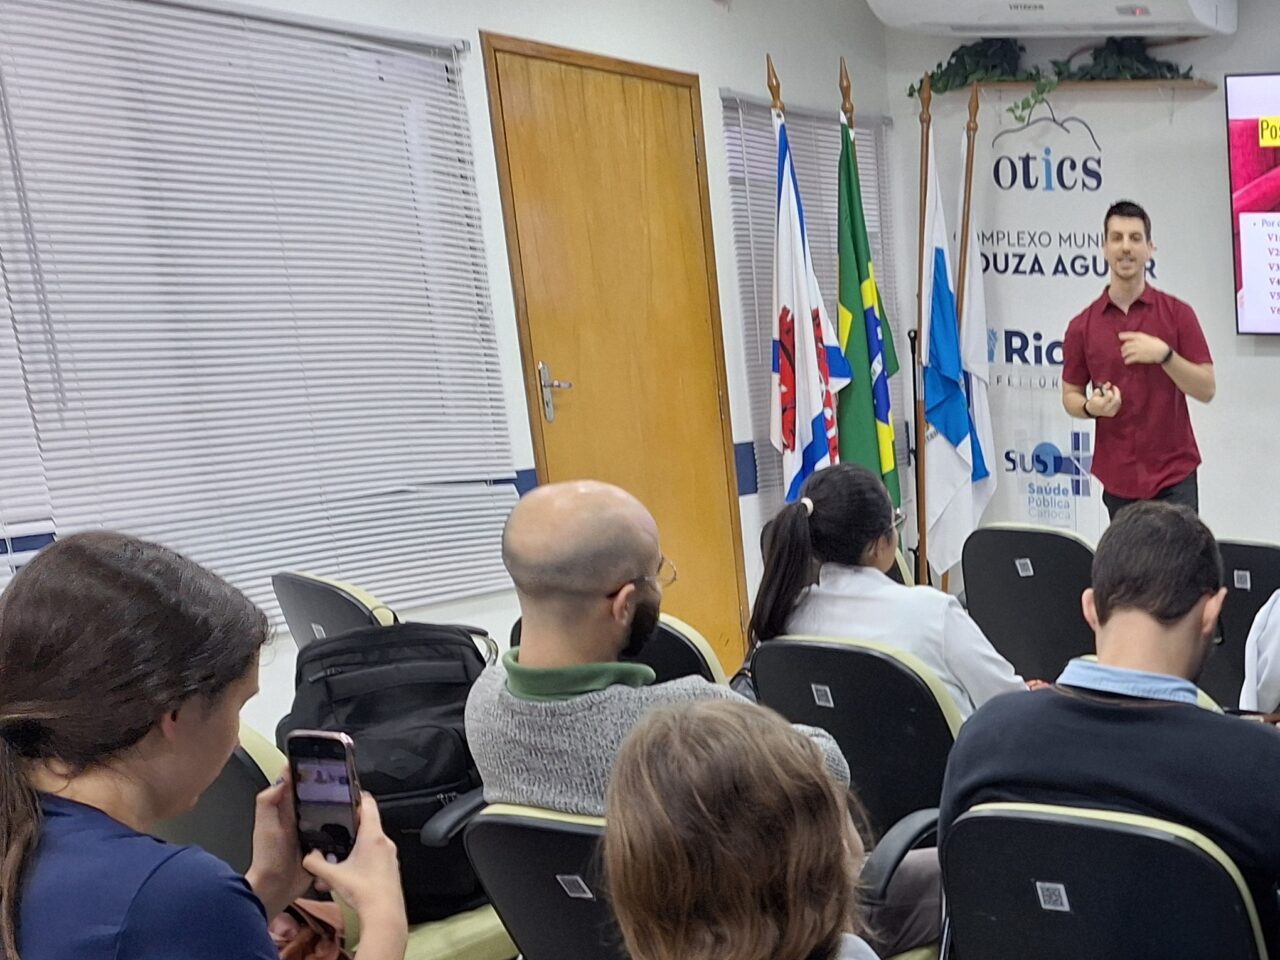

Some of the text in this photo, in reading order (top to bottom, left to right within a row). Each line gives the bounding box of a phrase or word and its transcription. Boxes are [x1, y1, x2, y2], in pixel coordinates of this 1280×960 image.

[993, 147, 1103, 192] otics
[1261, 218, 1275, 227] Por
[953, 231, 1052, 247] MPLEXO
[980, 252, 1157, 279] OUZA AGUR
[1004, 449, 1049, 474] SUS
[1028, 482, 1069, 496] Saúde
[1028, 496, 1070, 509] Pública
[1028, 508, 1071, 520] Carioca
